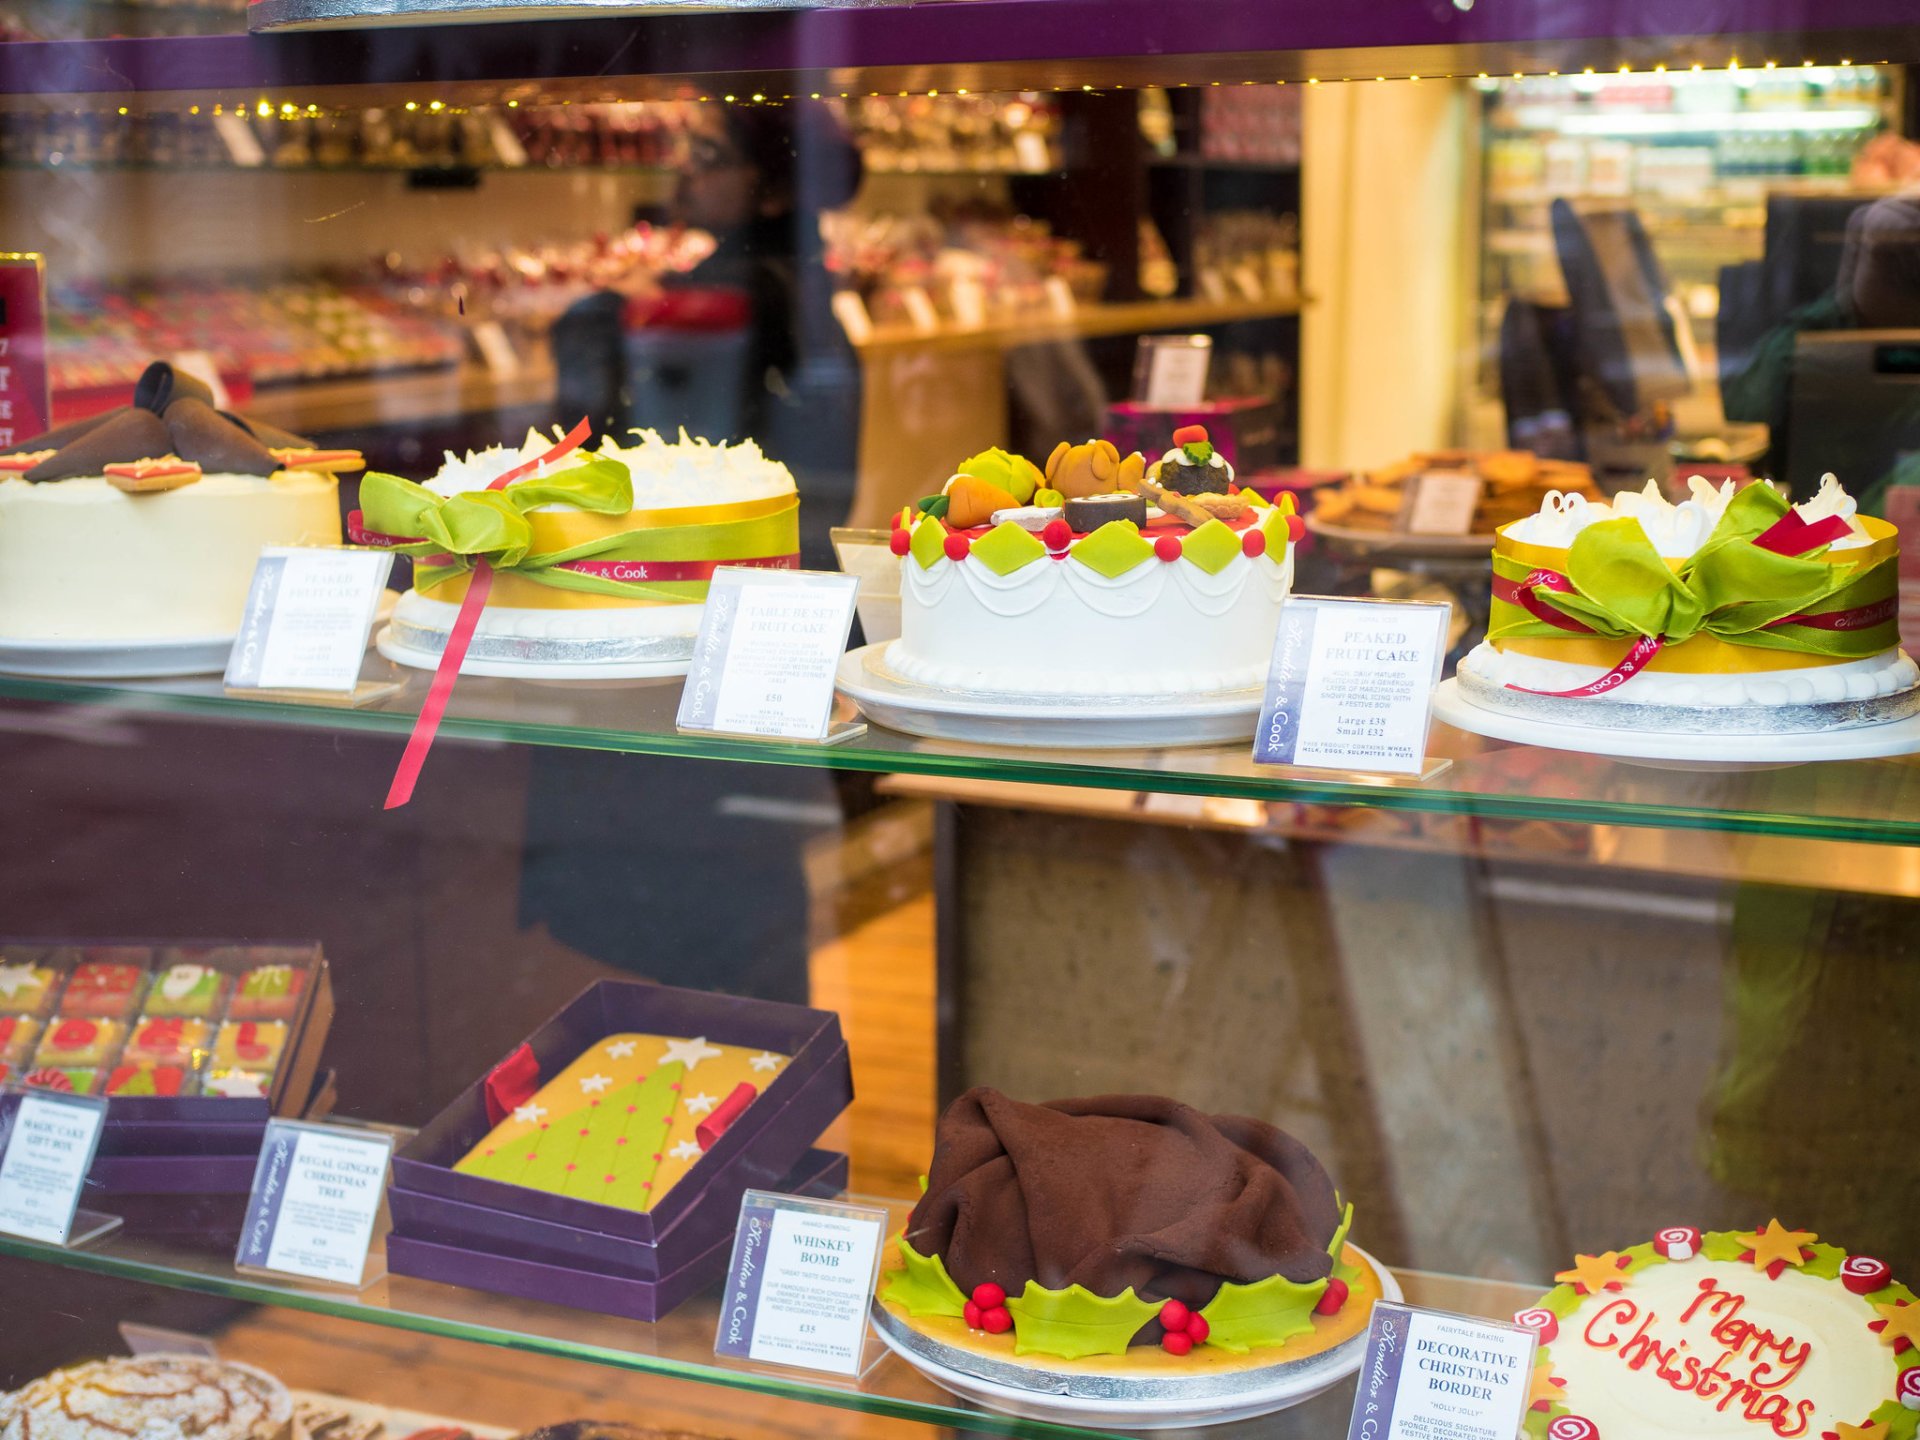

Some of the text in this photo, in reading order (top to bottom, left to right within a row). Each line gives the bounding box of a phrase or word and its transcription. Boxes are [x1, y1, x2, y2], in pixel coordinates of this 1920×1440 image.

[362, 532, 393, 547] Cook
[601, 569, 610, 579] &
[614, 566, 648, 579] Cook
[793, 608, 809, 618] BE
[750, 621, 827, 633] FRUIT CAKE
[1344, 631, 1407, 645] PEAKED
[1325, 648, 1420, 663] FRUIT CAKE
[701, 667, 712, 676] &
[1620, 662, 1634, 672] &
[1268, 617, 1304, 753] Konditor & Cook
[1585, 673, 1624, 693] Cook
[692, 682, 711, 719] Cook
[766, 693, 782, 703] £50
[1348, 693, 1369, 701] ROYAL
[1345, 701, 1374, 709] FESTIVE
[1338, 716, 1387, 726] Large £38
[1336, 728, 1385, 737] Small £32
[299, 1155, 380, 1176] REGAL GINGER
[304, 1170, 367, 1188] CHRISTMAS
[318, 1185, 345, 1199] TREE
[249, 1219, 269, 1256] Cook
[794, 1234, 855, 1253] WHISKEY
[800, 1252, 840, 1268] BOMB
[728, 1217, 763, 1345] Konditor & Cook
[776, 1290, 800, 1298] ORANGE
[835, 1298, 850, 1306] CAKE
[785, 1306, 820, 1316] DECORATED
[802, 1301, 836, 1311] CHOCOLATE
[800, 1324, 816, 1335] £35
[1437, 1324, 1505, 1344] FAIRYTALE BAKING
[1680, 1278, 1811, 1390] Merry
[1417, 1339, 1517, 1369] DECORATIVE
[1419, 1357, 1510, 1386] CHRISTMAS
[1584, 1299, 1814, 1438] Christmas
[1361, 1320, 1397, 1440] Konditor & Co
[1429, 1377, 1493, 1401] BORDER
[1430, 1402, 1484, 1417] "HOLLY JOLLY"
[1399, 1420, 1431, 1432] SPONGE,
[1433, 1427, 1477, 1440] DECORATED
[1413, 1415, 1453, 1428] DELICIOUS
[1455, 1424, 1497, 1437] SIGNATURE
[1401, 1429, 1432, 1440] FESTIVE
